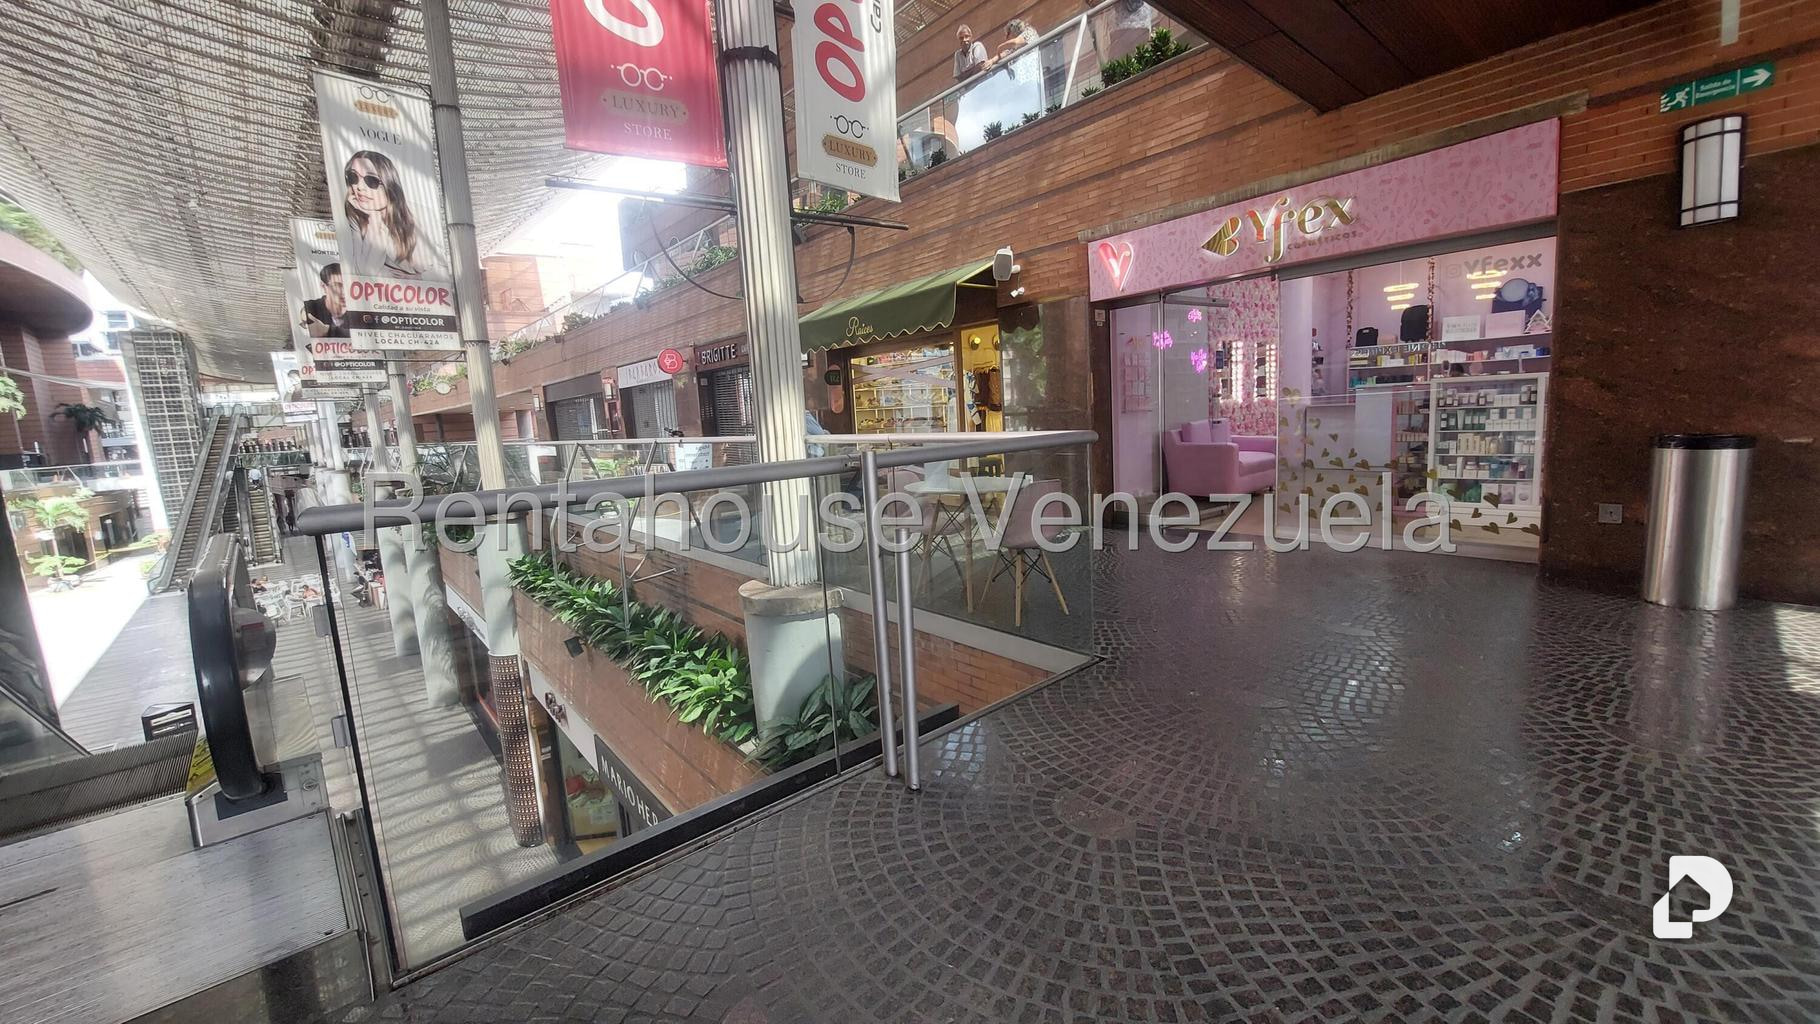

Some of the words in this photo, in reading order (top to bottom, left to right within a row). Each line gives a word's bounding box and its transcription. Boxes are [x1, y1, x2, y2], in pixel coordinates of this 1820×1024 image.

[612, 95, 680, 119] LUXURY
[359, 126, 402, 145] VOGUE
[623, 122, 673, 141] STORE
[828, 140, 872, 162] LUXURY
[835, 162, 866, 180] STORE
[350, 281, 451, 306] OPTICOLOR
[381, 315, 445, 327] @OPTICOLOR
[701, 343, 738, 365] BRIGITTE
